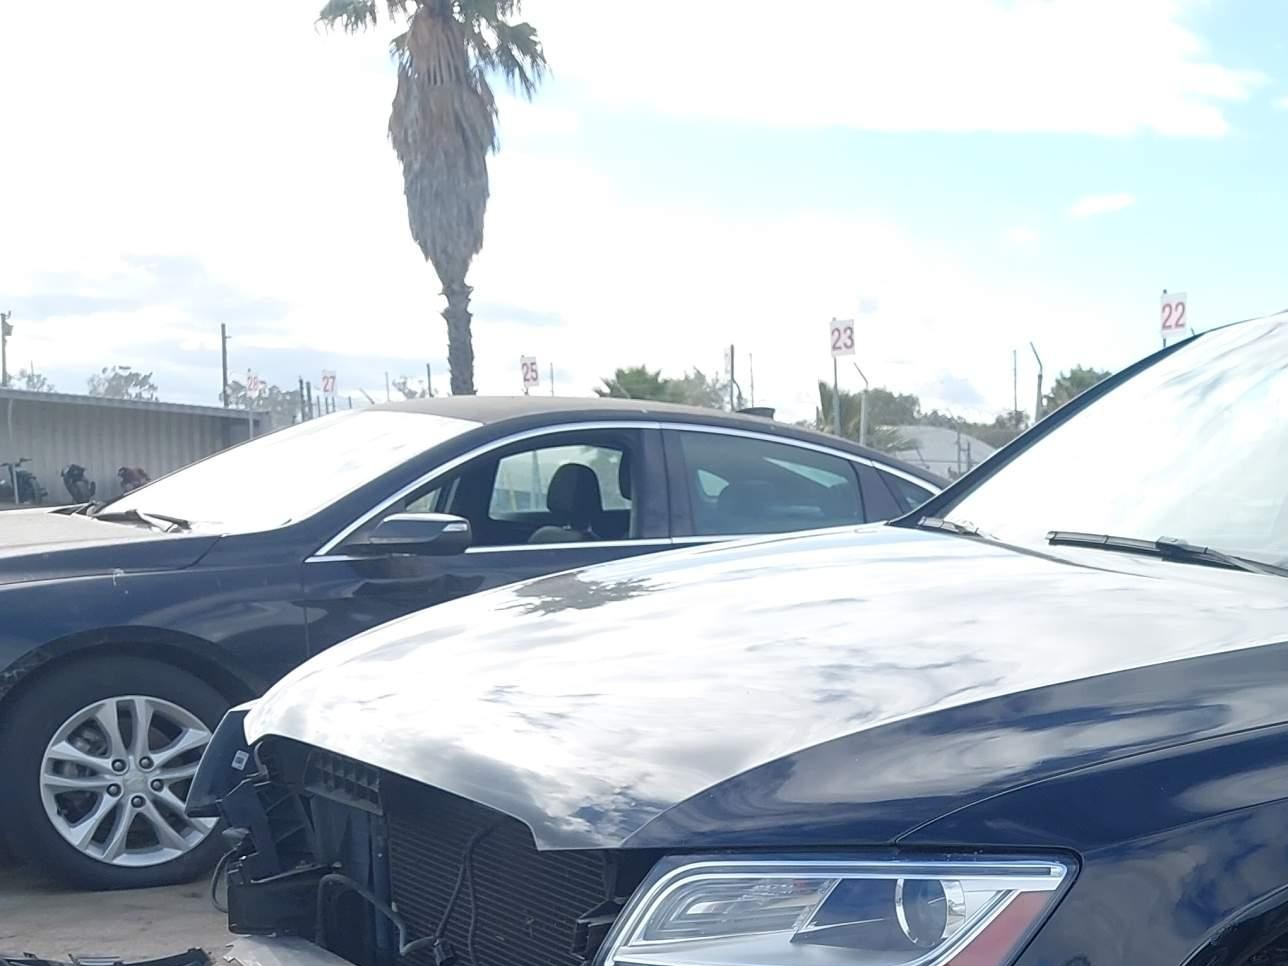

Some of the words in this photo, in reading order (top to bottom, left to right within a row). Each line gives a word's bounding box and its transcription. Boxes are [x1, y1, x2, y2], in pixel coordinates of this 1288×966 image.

[1161, 302, 1186, 330] 22
[831, 326, 855, 351] 23
[521, 362, 538, 382] 25
[321, 375, 337, 392] 27
